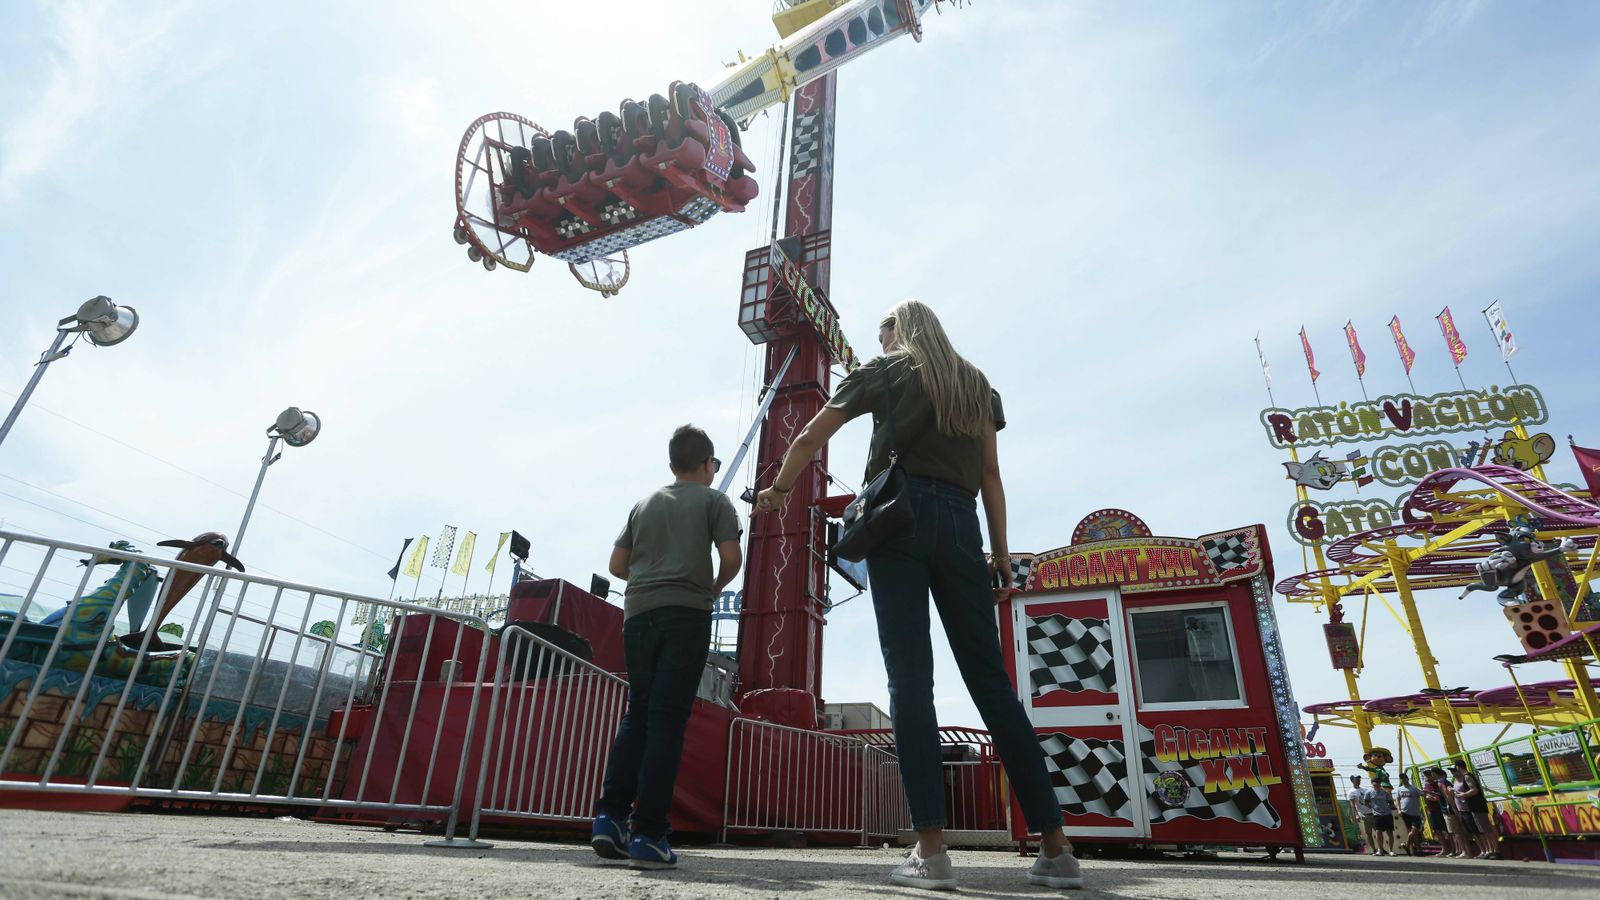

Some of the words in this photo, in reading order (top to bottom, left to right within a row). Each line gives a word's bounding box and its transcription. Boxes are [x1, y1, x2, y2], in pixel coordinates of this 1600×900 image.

[1383, 384, 1540, 431] VACILÓN
[1379, 447, 1452, 480] CON
[1295, 505, 1392, 540] GATO
[1040, 548, 1140, 590] GIGANT
[1145, 547, 1199, 579] XXL
[1154, 724, 1268, 763] GIGANT
[1540, 734, 1579, 752] ENTRADA
[1200, 755, 1282, 794] XXL
